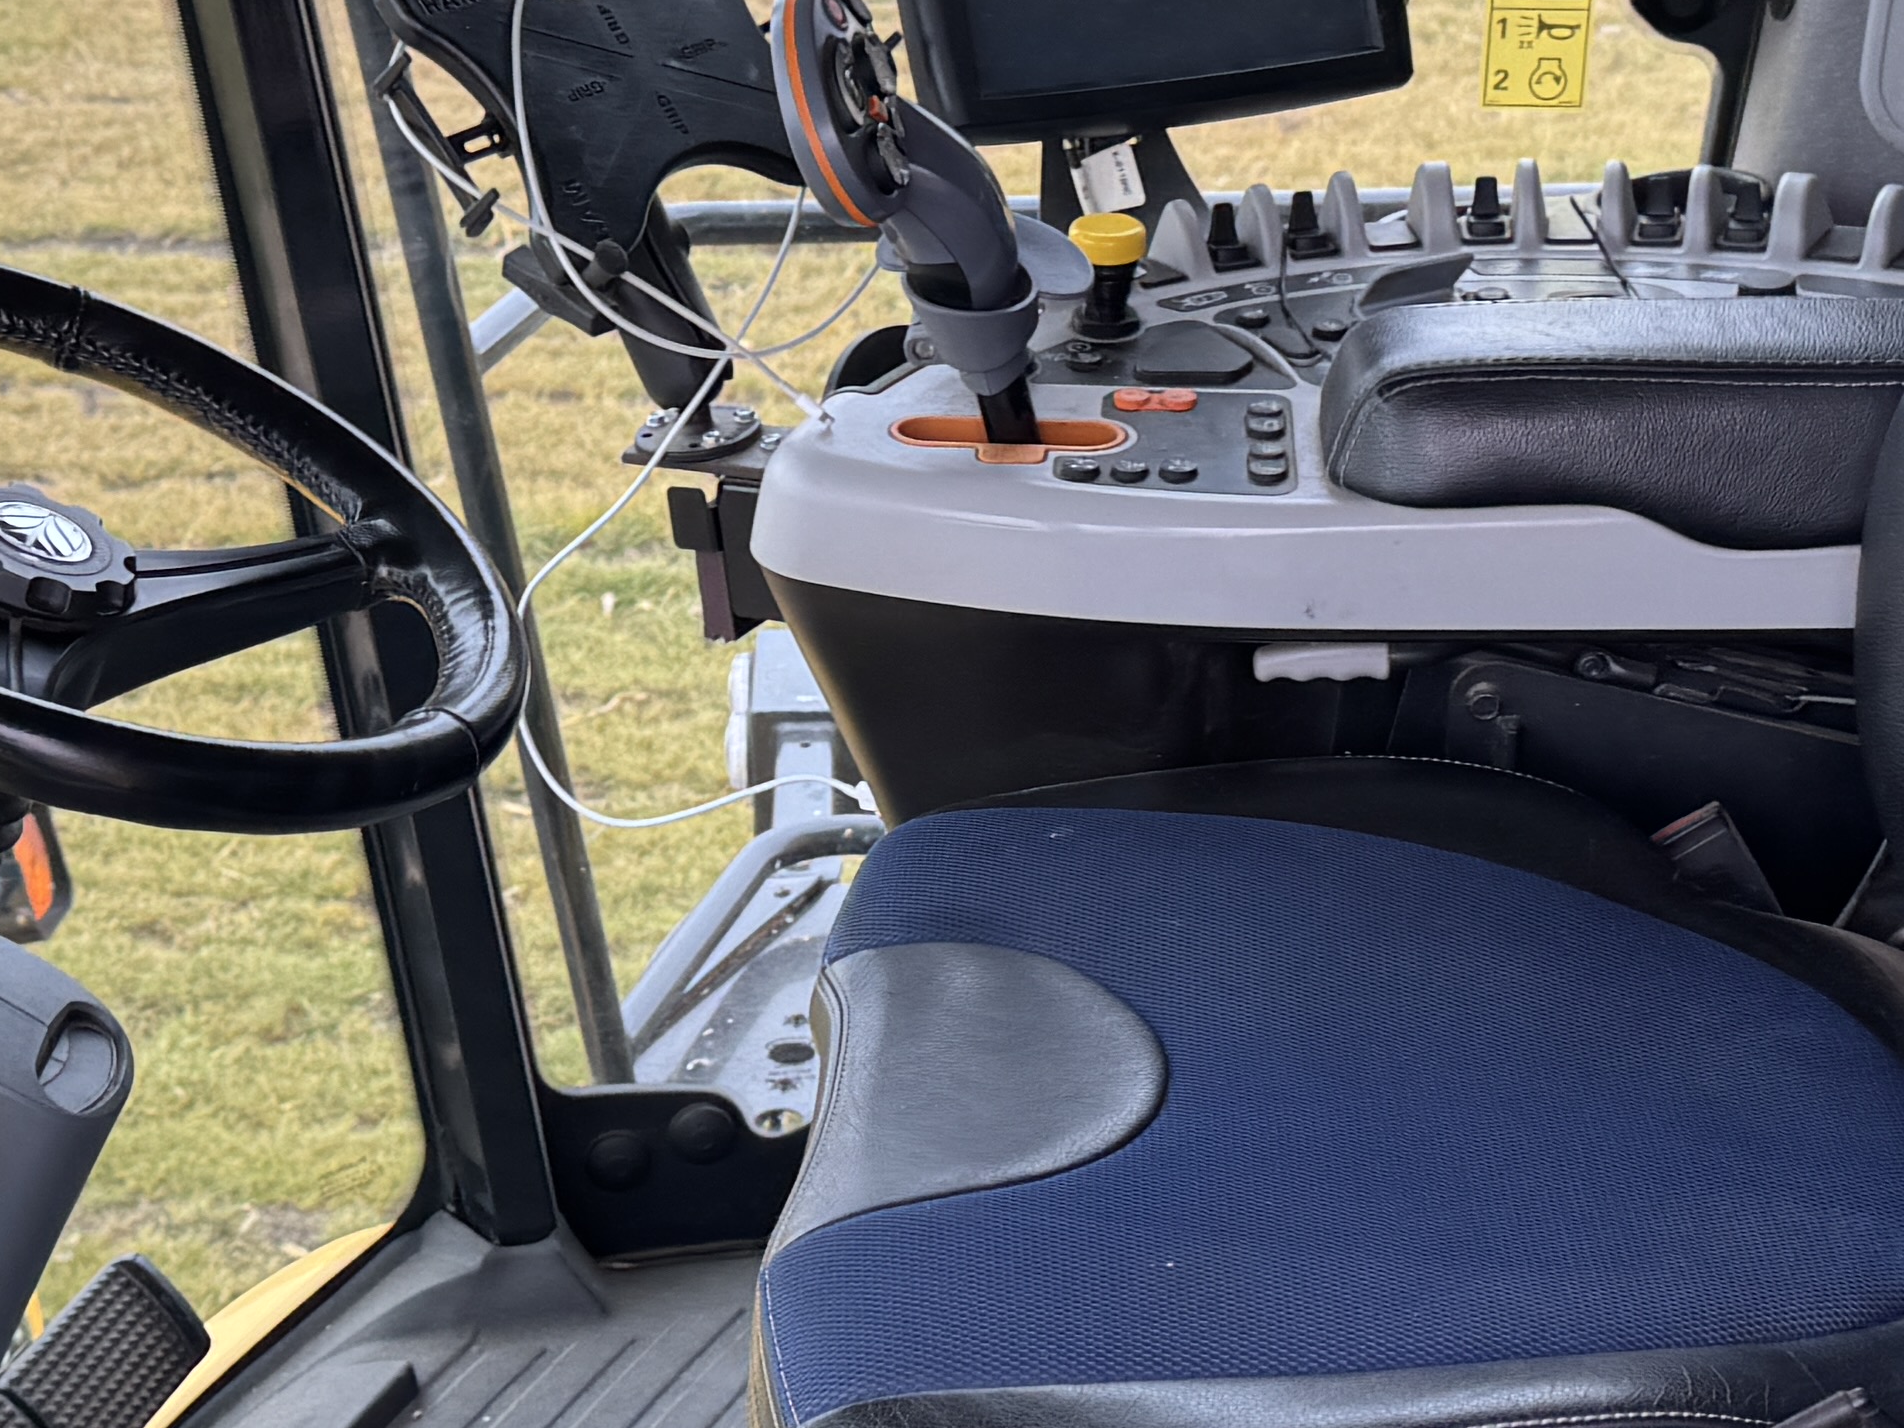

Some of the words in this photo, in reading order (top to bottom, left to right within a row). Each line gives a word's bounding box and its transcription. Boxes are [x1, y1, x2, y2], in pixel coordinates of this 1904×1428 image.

[1496, 17, 1508, 39] 1
[1493, 68, 1509, 91] 2
[567, 80, 606, 103] GRIP
